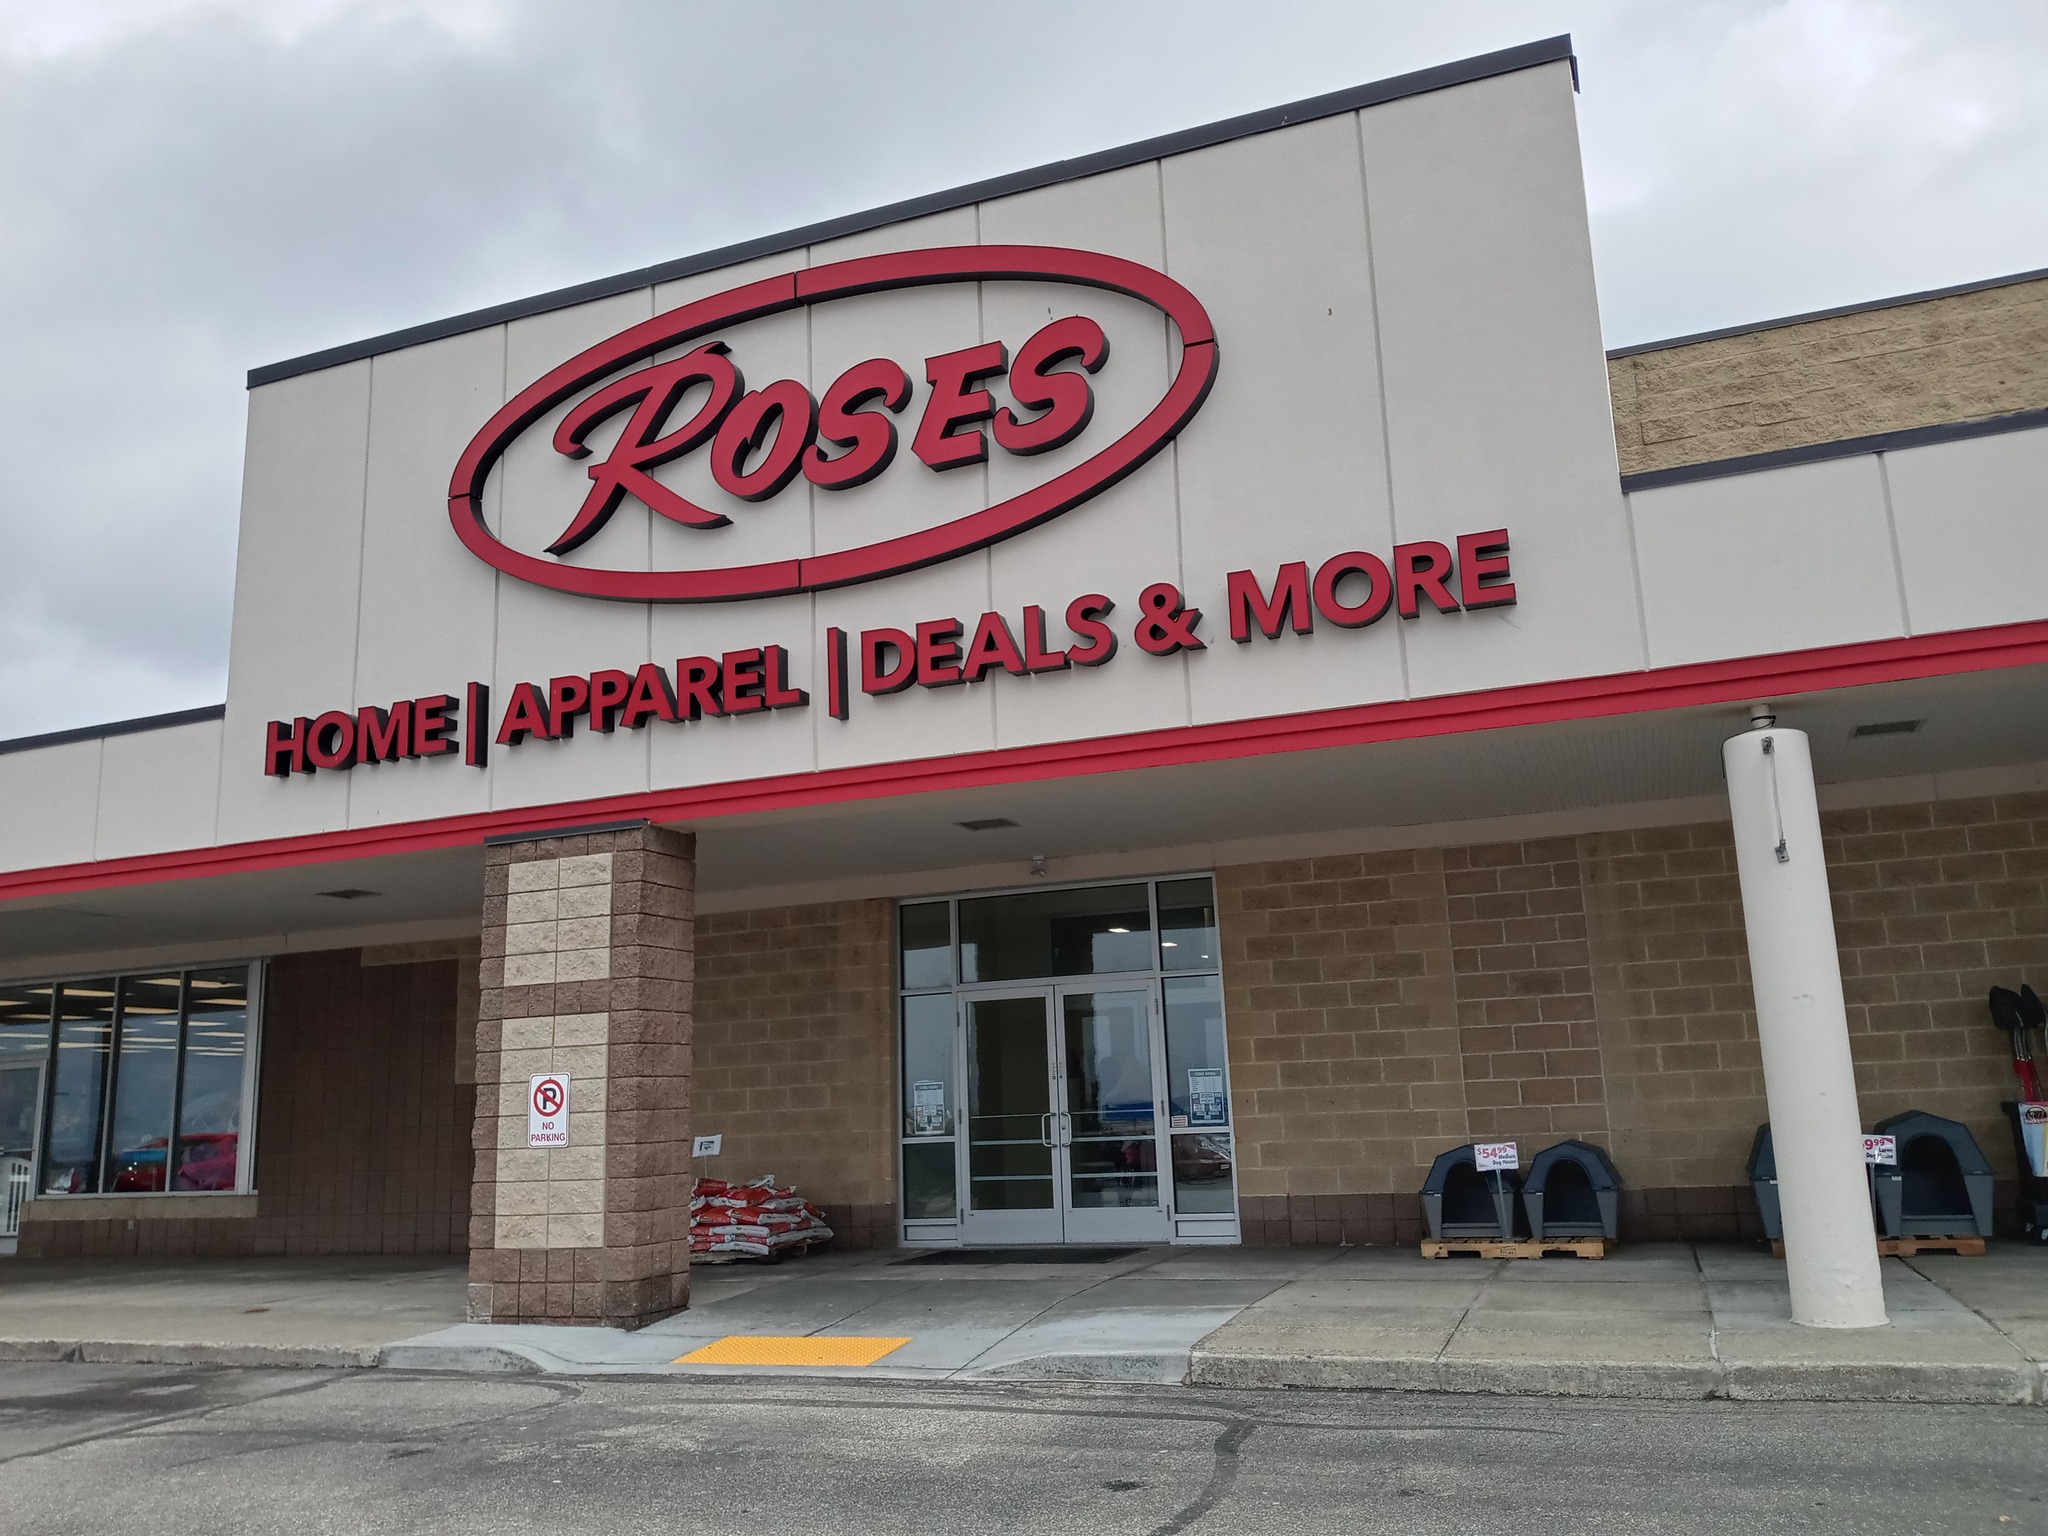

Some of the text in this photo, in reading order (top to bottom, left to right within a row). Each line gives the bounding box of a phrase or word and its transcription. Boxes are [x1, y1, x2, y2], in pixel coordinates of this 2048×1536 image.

[543, 316, 1110, 557] ROSES
[265, 694, 459, 777] HOME
[496, 644, 809, 746] APPAREL
[860, 593, 1119, 697] DEALS
[1134, 582, 1207, 658] &
[1226, 528, 1517, 643] MORE
[531, 1133, 566, 1142] PARKING
[542, 1121, 555, 1130] NO
